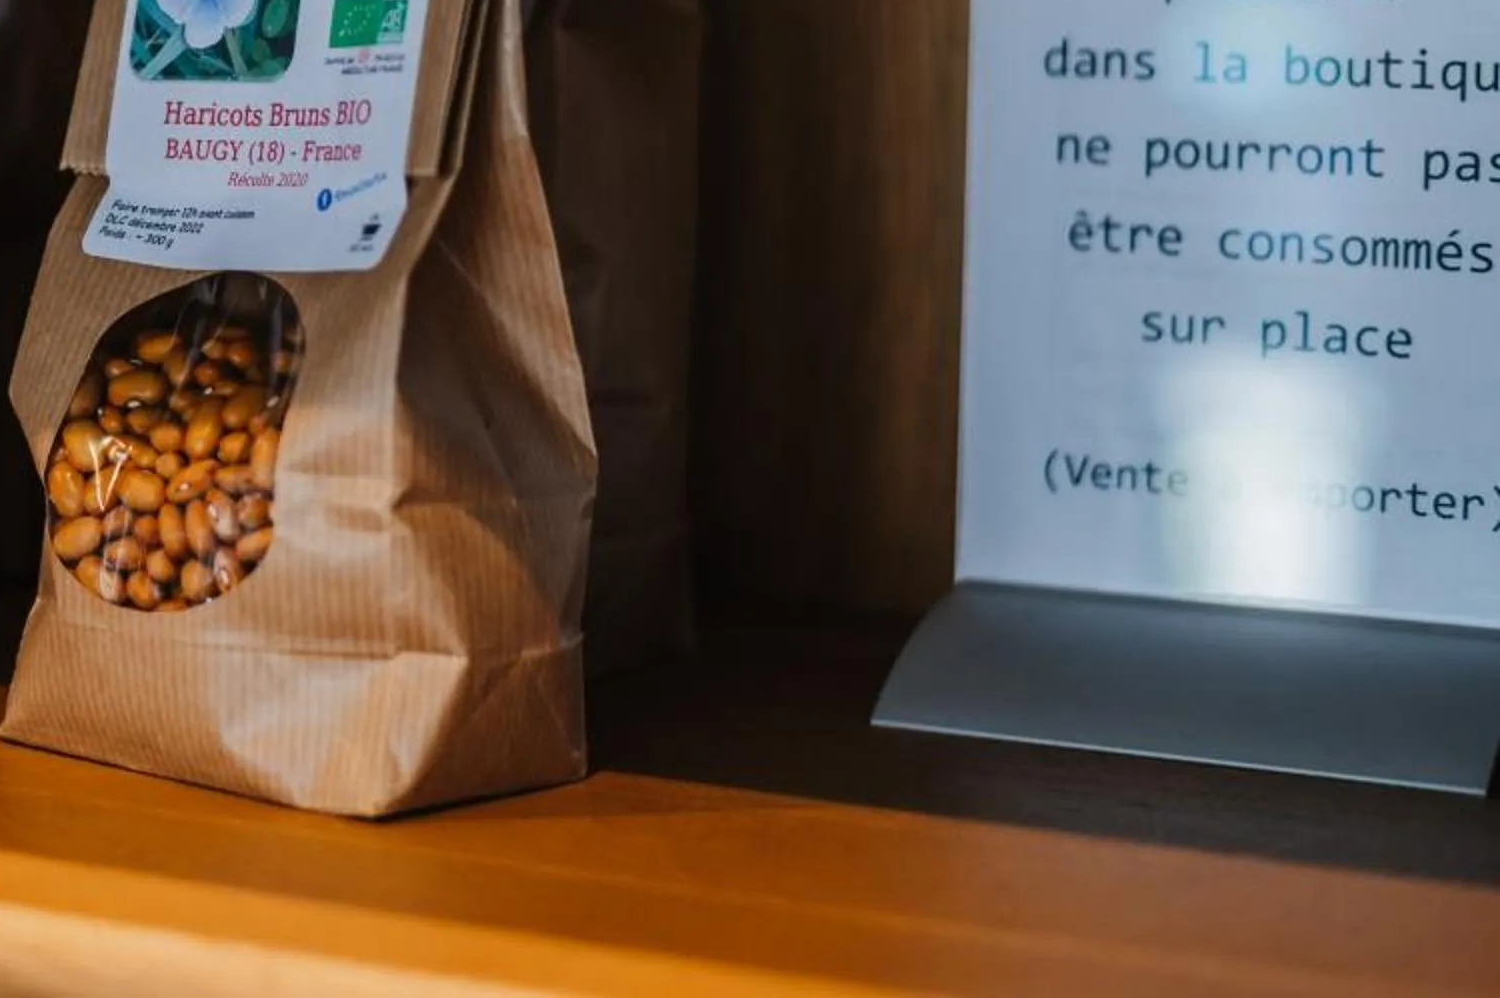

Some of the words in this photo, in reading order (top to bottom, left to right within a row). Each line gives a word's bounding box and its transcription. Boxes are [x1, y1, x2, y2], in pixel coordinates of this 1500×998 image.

[1042, 37, 1156, 81] dans
[1193, 40, 1249, 85] la
[1284, 44, 1500, 103] boutiqu
[164, 101, 263, 127] Haricots
[269, 102, 331, 128] Bruns
[335, 100, 372, 125] BIO
[165, 138, 244, 161] BAUGY
[248, 140, 286, 165] (18)
[302, 140, 362, 162] France
[1056, 133, 1112, 165] ne
[1144, 135, 1386, 180] pourront
[1422, 149, 1500, 192] pas
[1067, 210, 1184, 257] être
[1218, 228, 1494, 274] consommés
[1141, 309, 1227, 344] sur
[1260, 310, 1414, 360] place
[1042, 448, 1190, 498] (Vente
